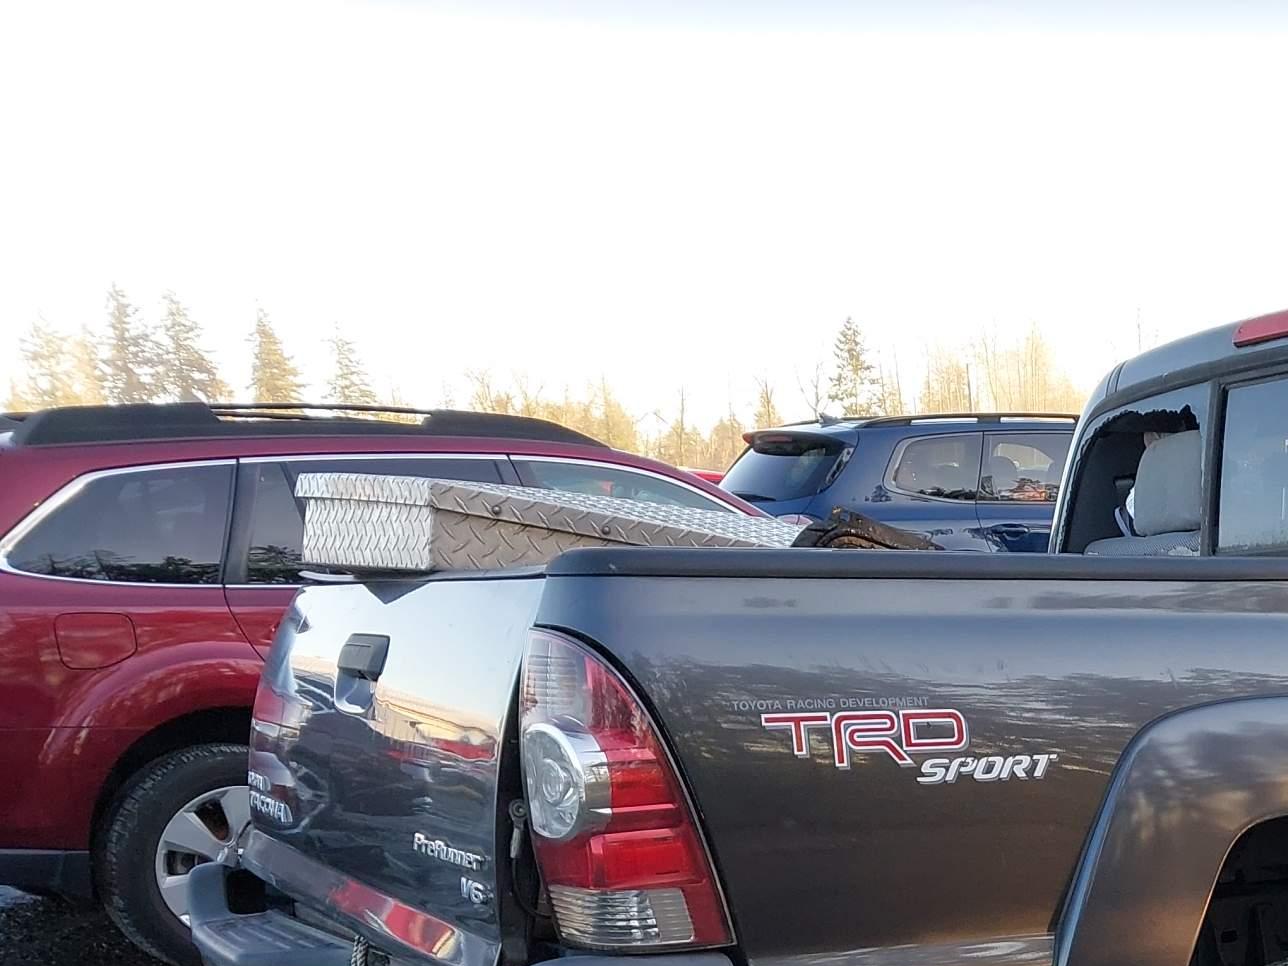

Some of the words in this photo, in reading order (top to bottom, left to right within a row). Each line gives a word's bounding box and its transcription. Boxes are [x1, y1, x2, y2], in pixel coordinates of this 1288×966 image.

[732, 699, 782, 711] TOYOTA
[786, 698, 836, 710] RACING
[839, 696, 929, 709] DEVELOPMENT
[761, 709, 969, 769] TRD
[916, 753, 1057, 784] SPORT
[413, 832, 482, 871] PreRunner
[461, 877, 484, 904] V6
